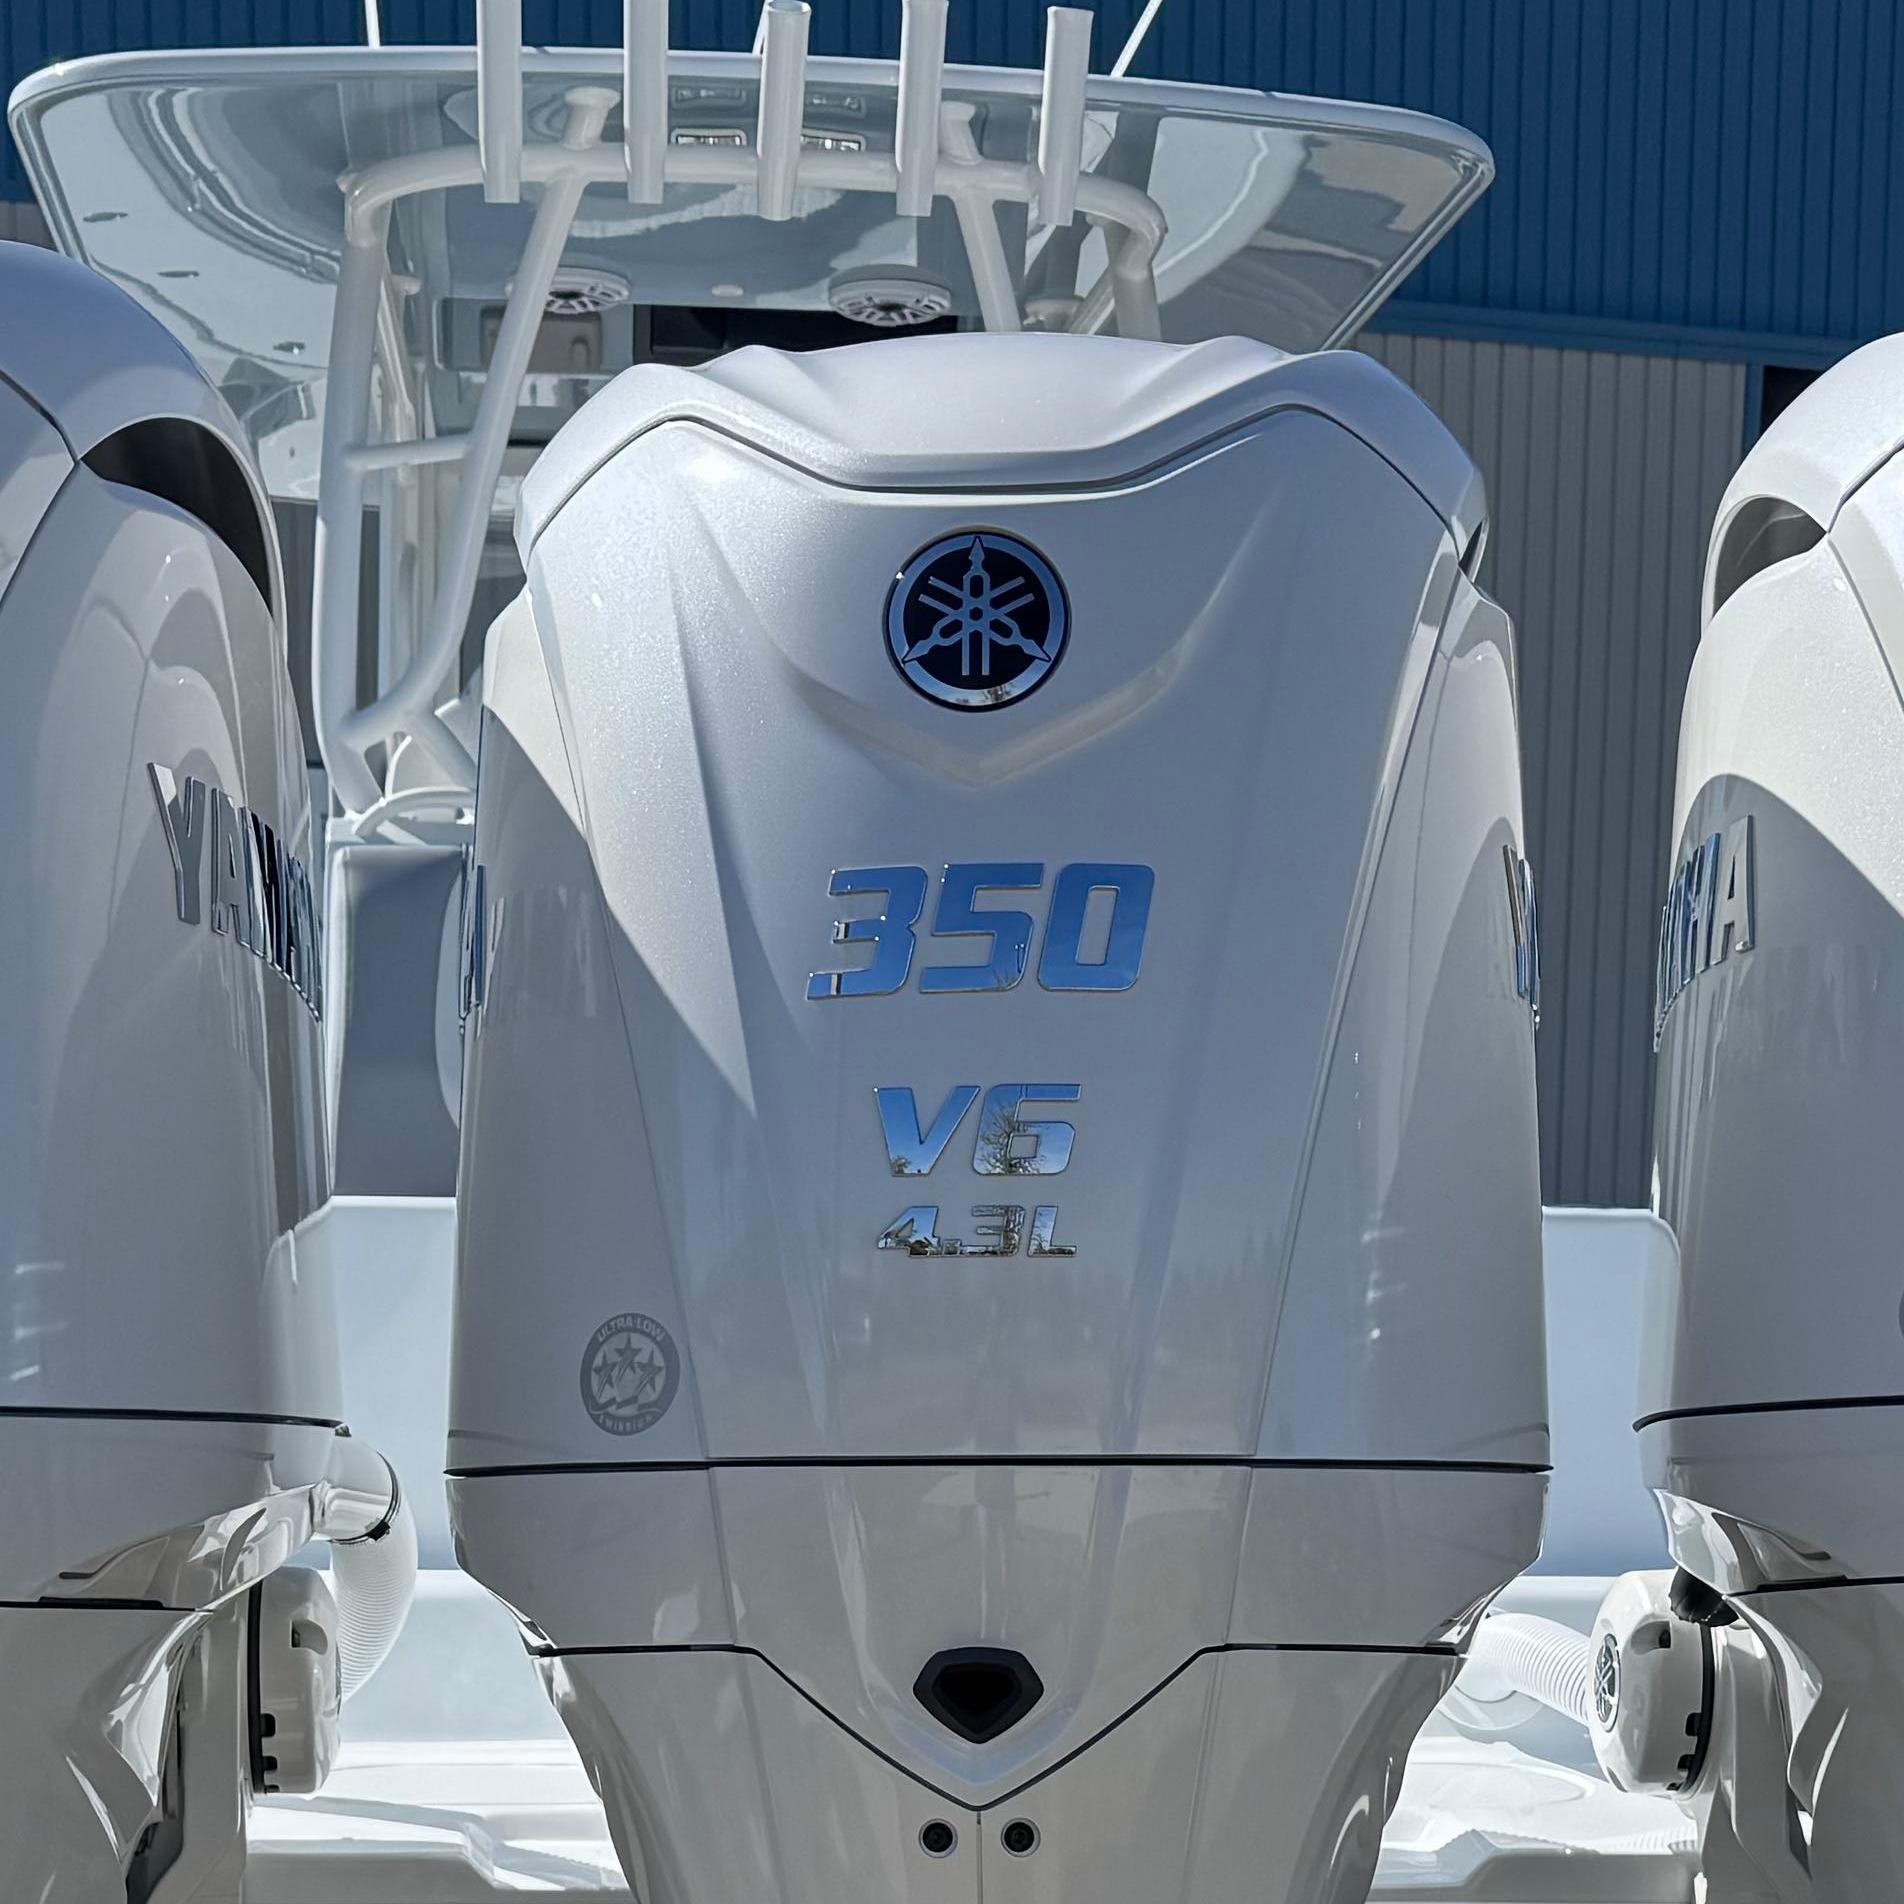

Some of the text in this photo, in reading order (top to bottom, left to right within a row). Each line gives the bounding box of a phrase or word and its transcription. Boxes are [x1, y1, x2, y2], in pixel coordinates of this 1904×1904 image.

[805, 862, 1156, 1001] 350
[873, 1083, 1082, 1178] V6
[876, 1204, 1078, 1258] 4.3L
